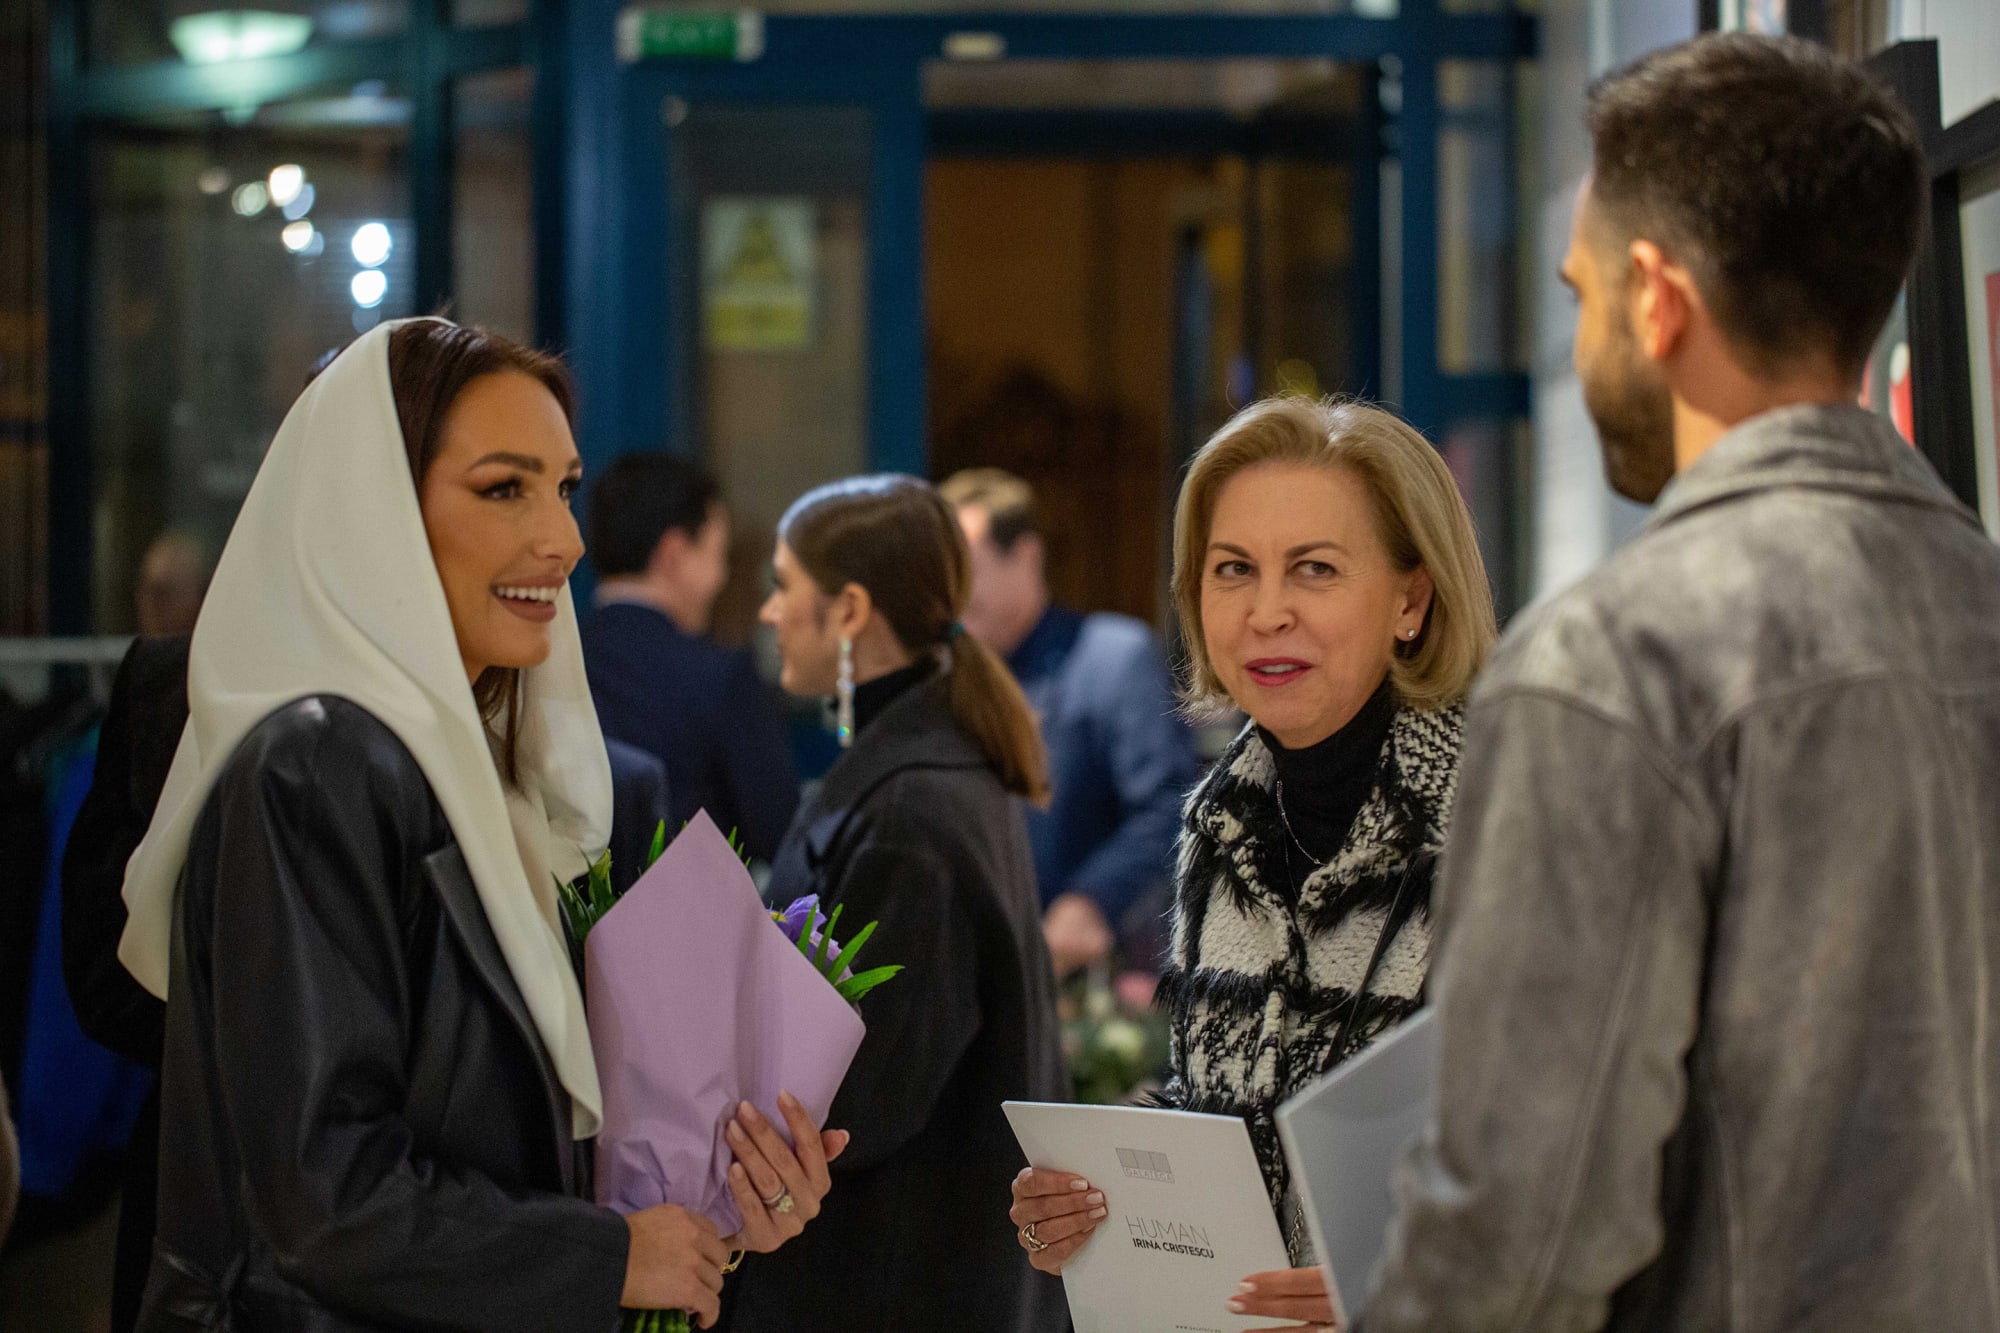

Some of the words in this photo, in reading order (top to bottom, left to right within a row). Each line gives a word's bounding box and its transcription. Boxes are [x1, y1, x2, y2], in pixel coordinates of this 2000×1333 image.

[1125, 1215, 1210, 1247] HUMAN
[1132, 1238, 1161, 1251] IRINA
[1162, 1242, 1214, 1259] CRISTESCU
